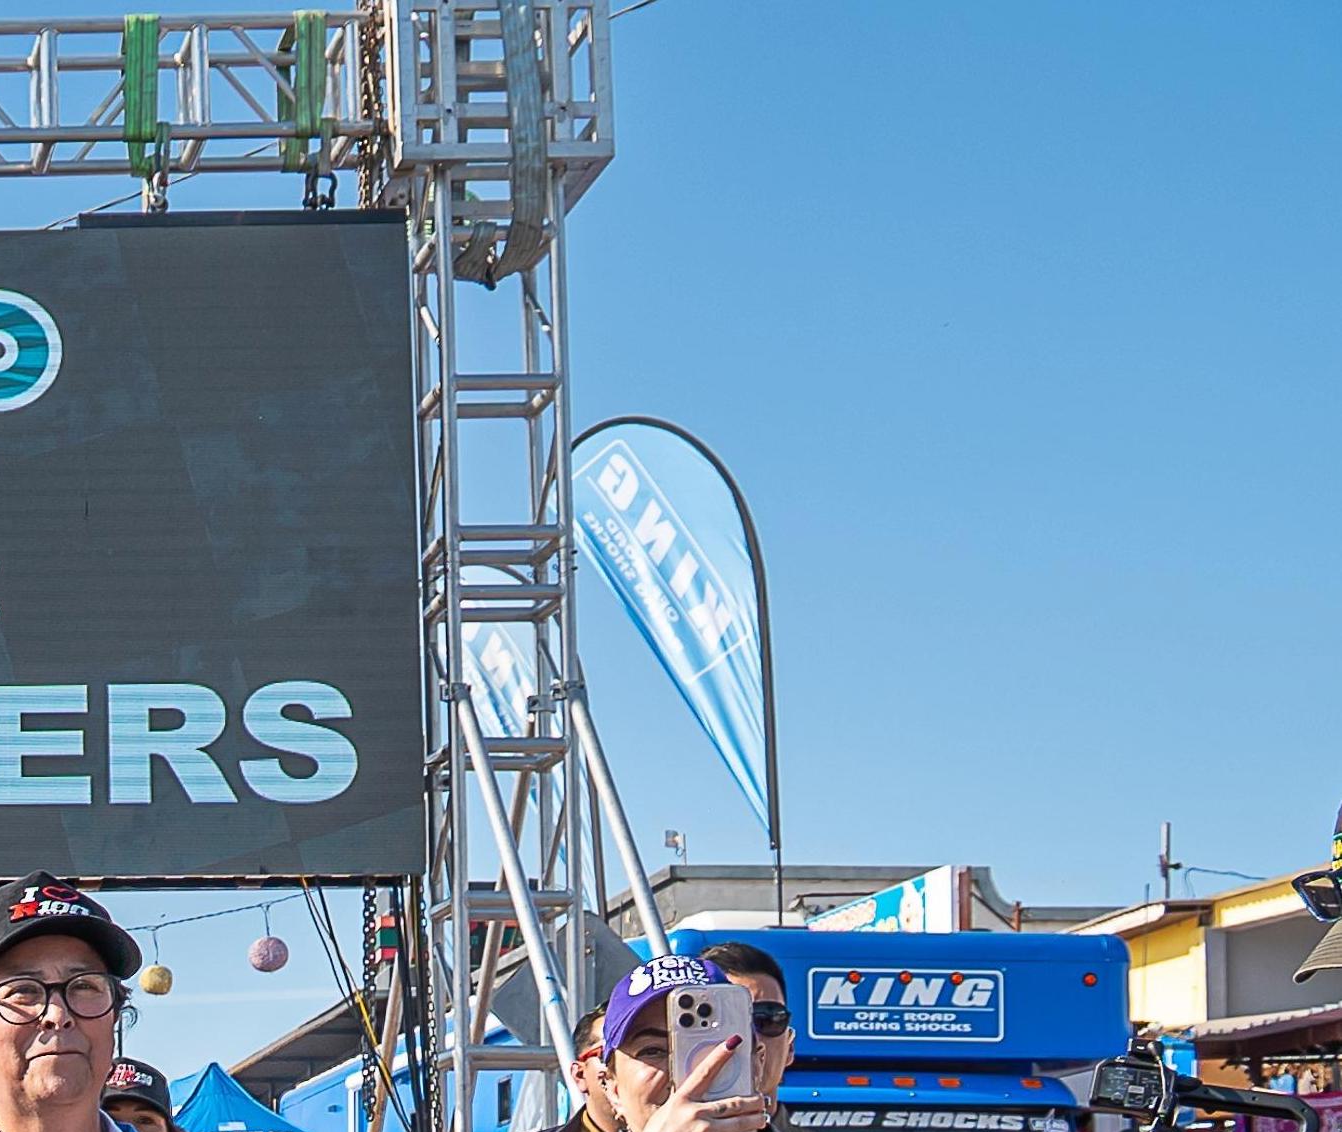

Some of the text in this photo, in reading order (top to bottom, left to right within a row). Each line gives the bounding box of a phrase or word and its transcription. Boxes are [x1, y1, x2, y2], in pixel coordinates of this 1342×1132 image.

[817, 976, 995, 1007] KING
[855, 1012, 888, 1021] OFF
[903, 1012, 956, 1021] ROAD
[834, 1021, 972, 1032] RACING SHOCKS
[790, 1111, 875, 1128] KING
[882, 1112, 1024, 1131] SHOCKS
